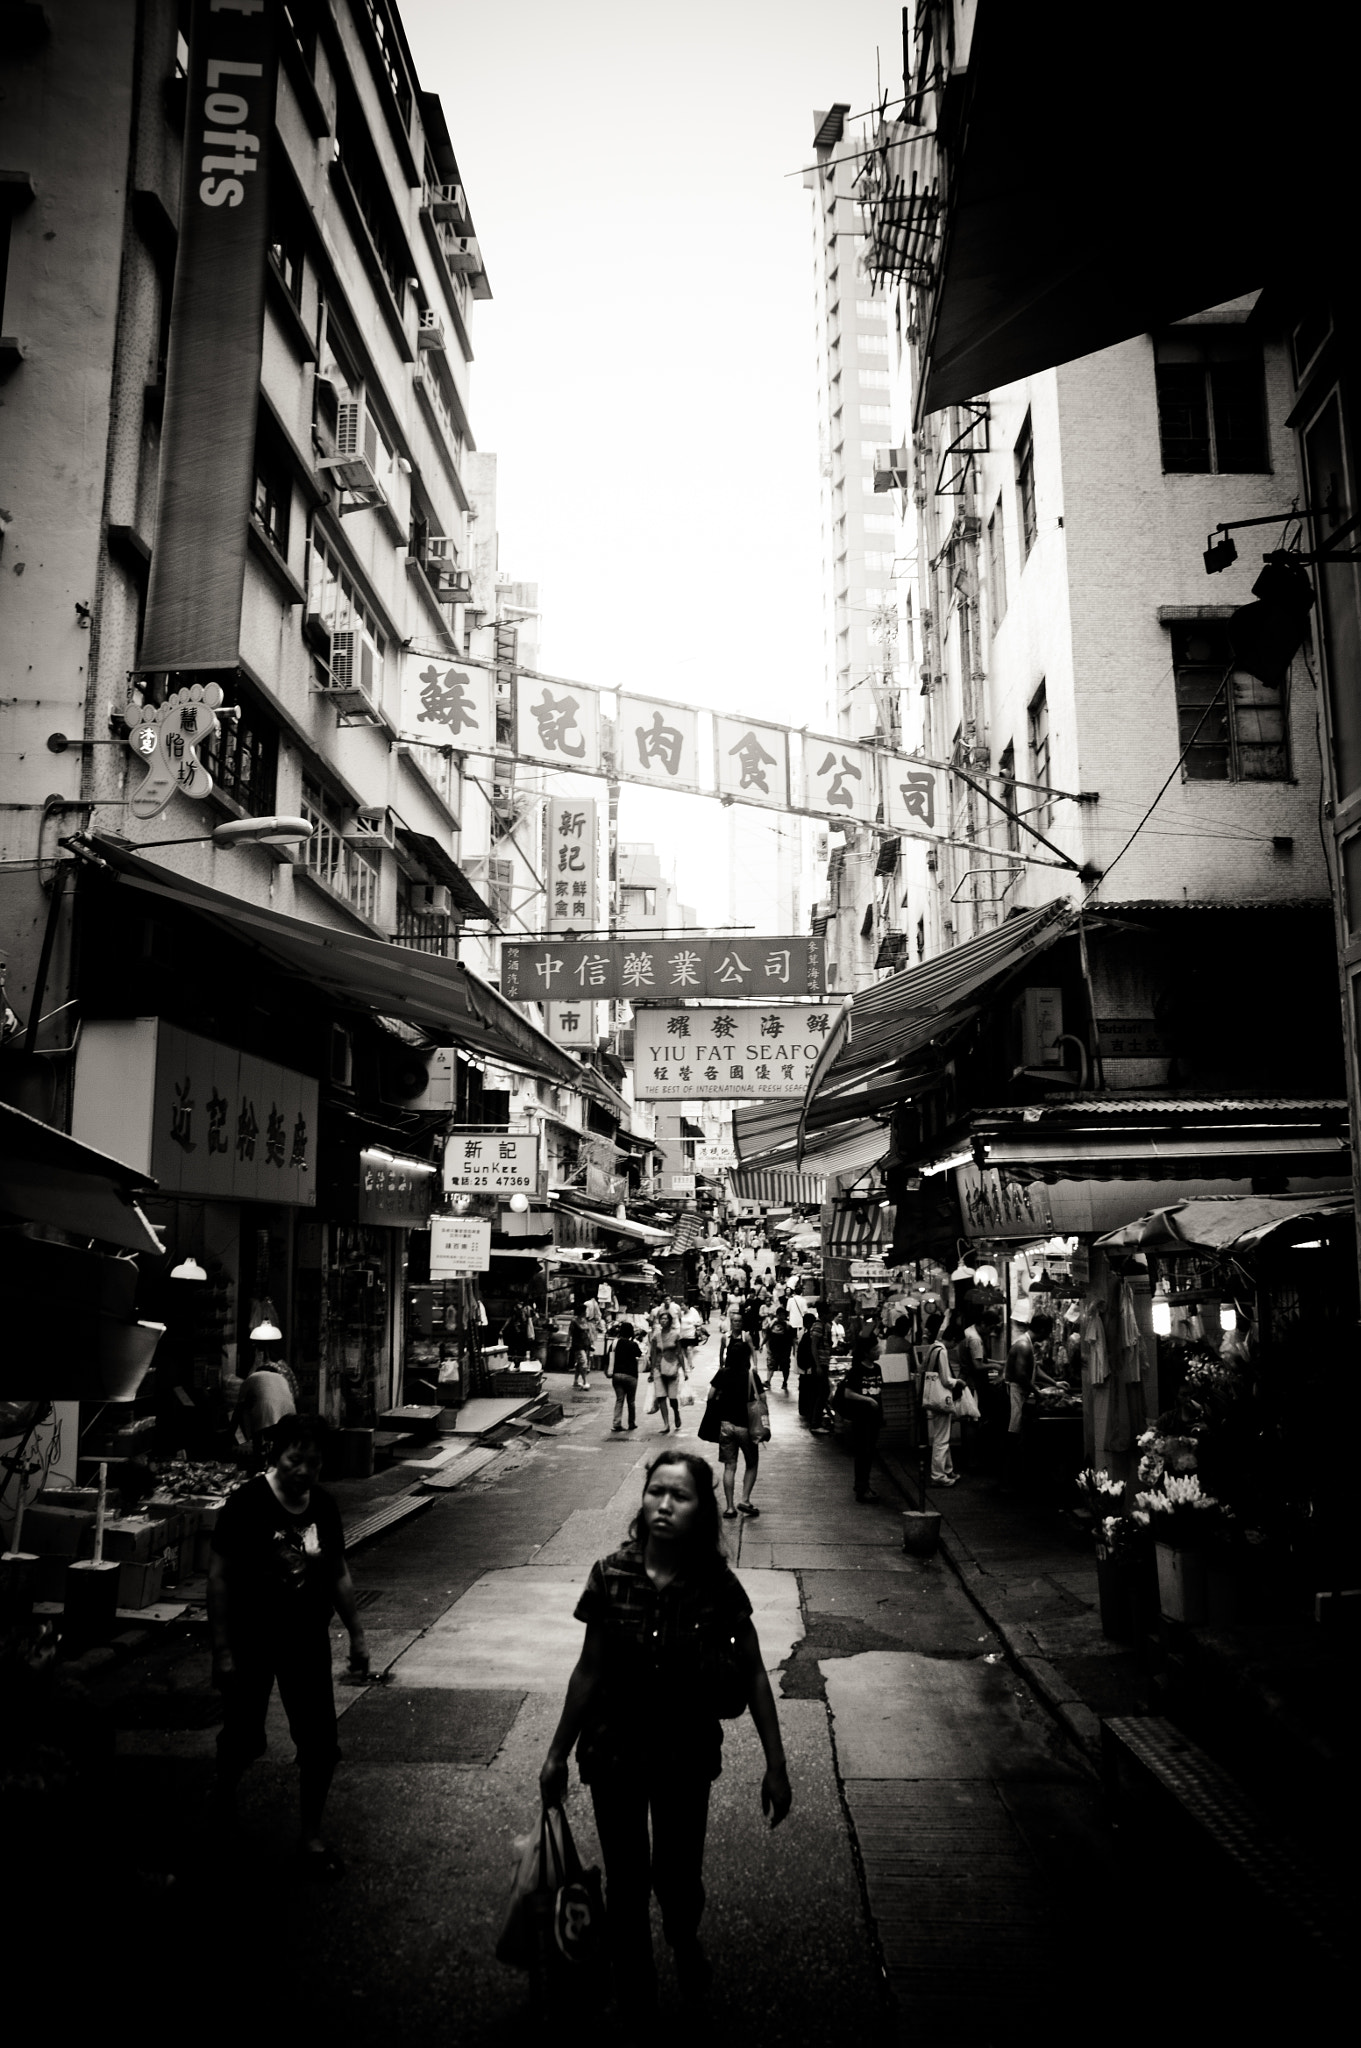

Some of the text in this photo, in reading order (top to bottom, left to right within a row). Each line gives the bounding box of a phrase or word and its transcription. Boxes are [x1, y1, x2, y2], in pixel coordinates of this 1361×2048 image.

[199, 58, 263, 207] Lofts
[166, 707, 198, 786] 慧怡坊
[417, 664, 936, 829] 蘇記肉食公司
[558, 810, 587, 872] 新記
[534, 949, 791, 990] 中信藥業公司
[666, 1014, 831, 1039] 耀發海鮮
[649, 1046, 686, 1061] YIU
[696, 1045, 736, 1061] FAT
[645, 1086, 660, 1094] THE
[662, 1086, 680, 1094] BEST
[683, 1085, 693, 1094] OF
[696, 1085, 755, 1093] INTERNATIONAL
[758, 1085, 782, 1093] FRESH
[464, 1140, 517, 1159] 新記
[496, 1177, 530, 1186] 47369
